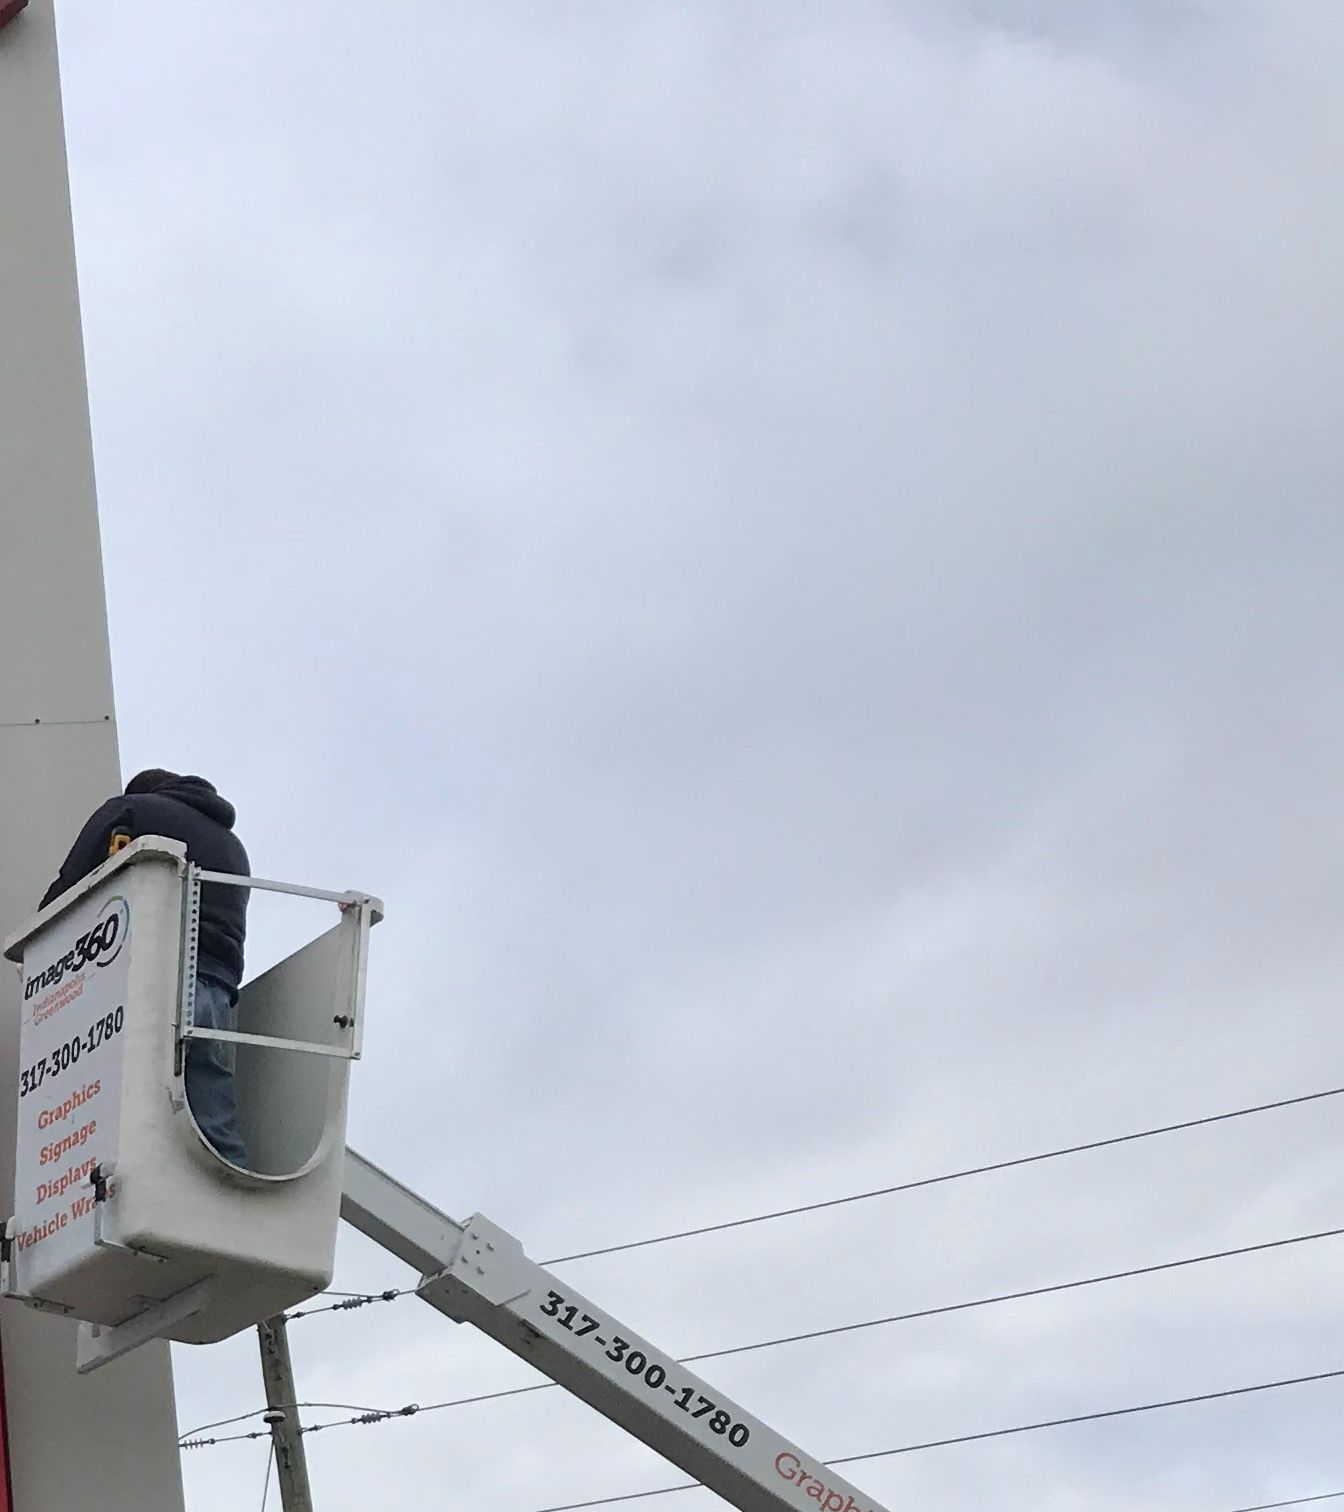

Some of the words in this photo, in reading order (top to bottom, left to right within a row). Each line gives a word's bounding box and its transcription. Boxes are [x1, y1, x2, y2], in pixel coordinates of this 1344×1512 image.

[25, 913, 119, 1000] image360
[20, 1005, 124, 1097] 317-300-1780
[37, 1079, 102, 1130] Graphics
[39, 1119, 97, 1166] Signage
[15, 1212, 69, 1252] Vehicle
[539, 1290, 750, 1448] 317-300-1780
